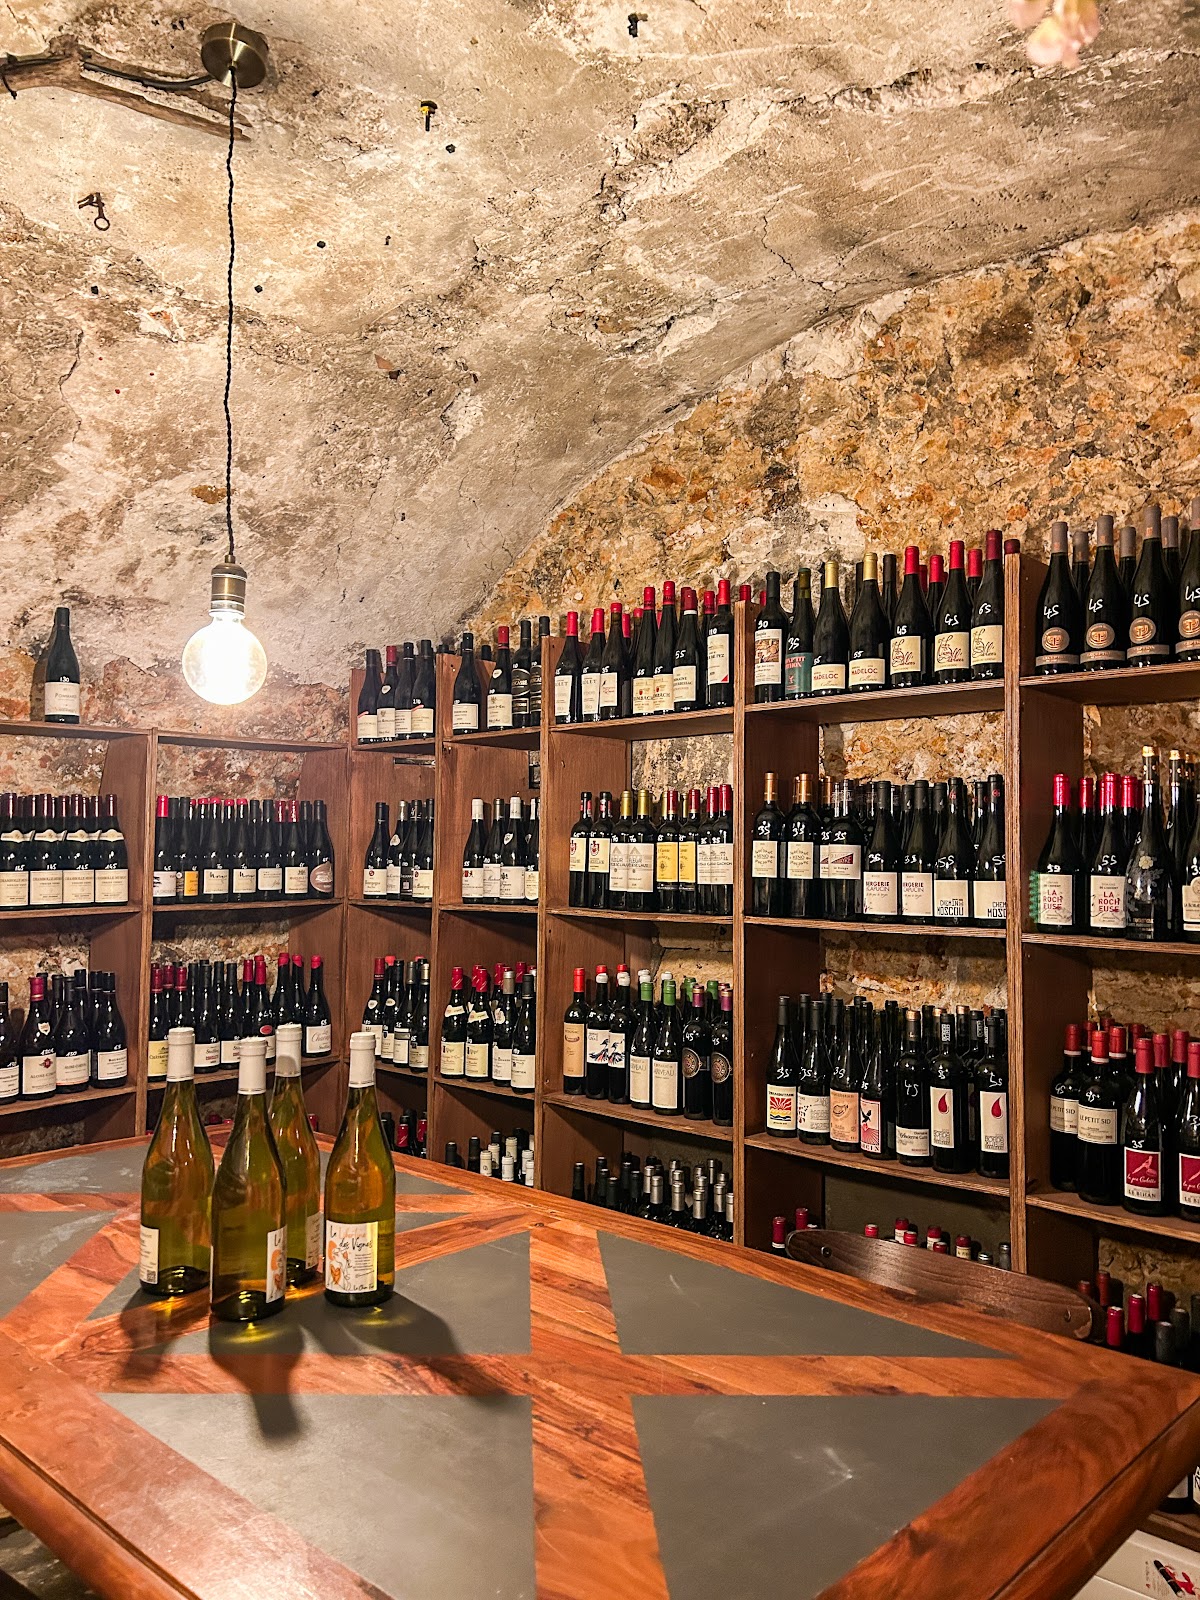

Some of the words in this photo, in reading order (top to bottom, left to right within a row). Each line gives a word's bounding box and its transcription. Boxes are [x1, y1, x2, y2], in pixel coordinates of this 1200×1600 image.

[1133, 594, 1150, 607] 45
[978, 602, 992, 615] 65
[1088, 599, 1104, 613] 45
[1043, 604, 1060, 619] 45
[896, 625, 908, 635] 45
[787, 637, 800, 650] 35
[675, 649, 687, 659] 55
[851, 667, 878, 676] MADELOC
[813, 673, 839, 681] MADELOC
[757, 823, 771, 836] 35
[1101, 854, 1118, 866] 55
[1042, 895, 1063, 903] ROCH
[1098, 897, 1121, 906] ROCH
[936, 907, 964, 916] MOSCOU
[1098, 905, 1120, 913] EUSE
[685, 1032, 695, 1042] 45
[776, 1066, 790, 1080] 35
[904, 1080, 919, 1097] 45
[1054, 1083, 1066, 1094] 45
[1085, 1115, 1100, 1123] PETIT
[1131, 1139, 1145, 1149] 35
[339, 1237, 350, 1249] des
[351, 1236, 373, 1251] Vignes
